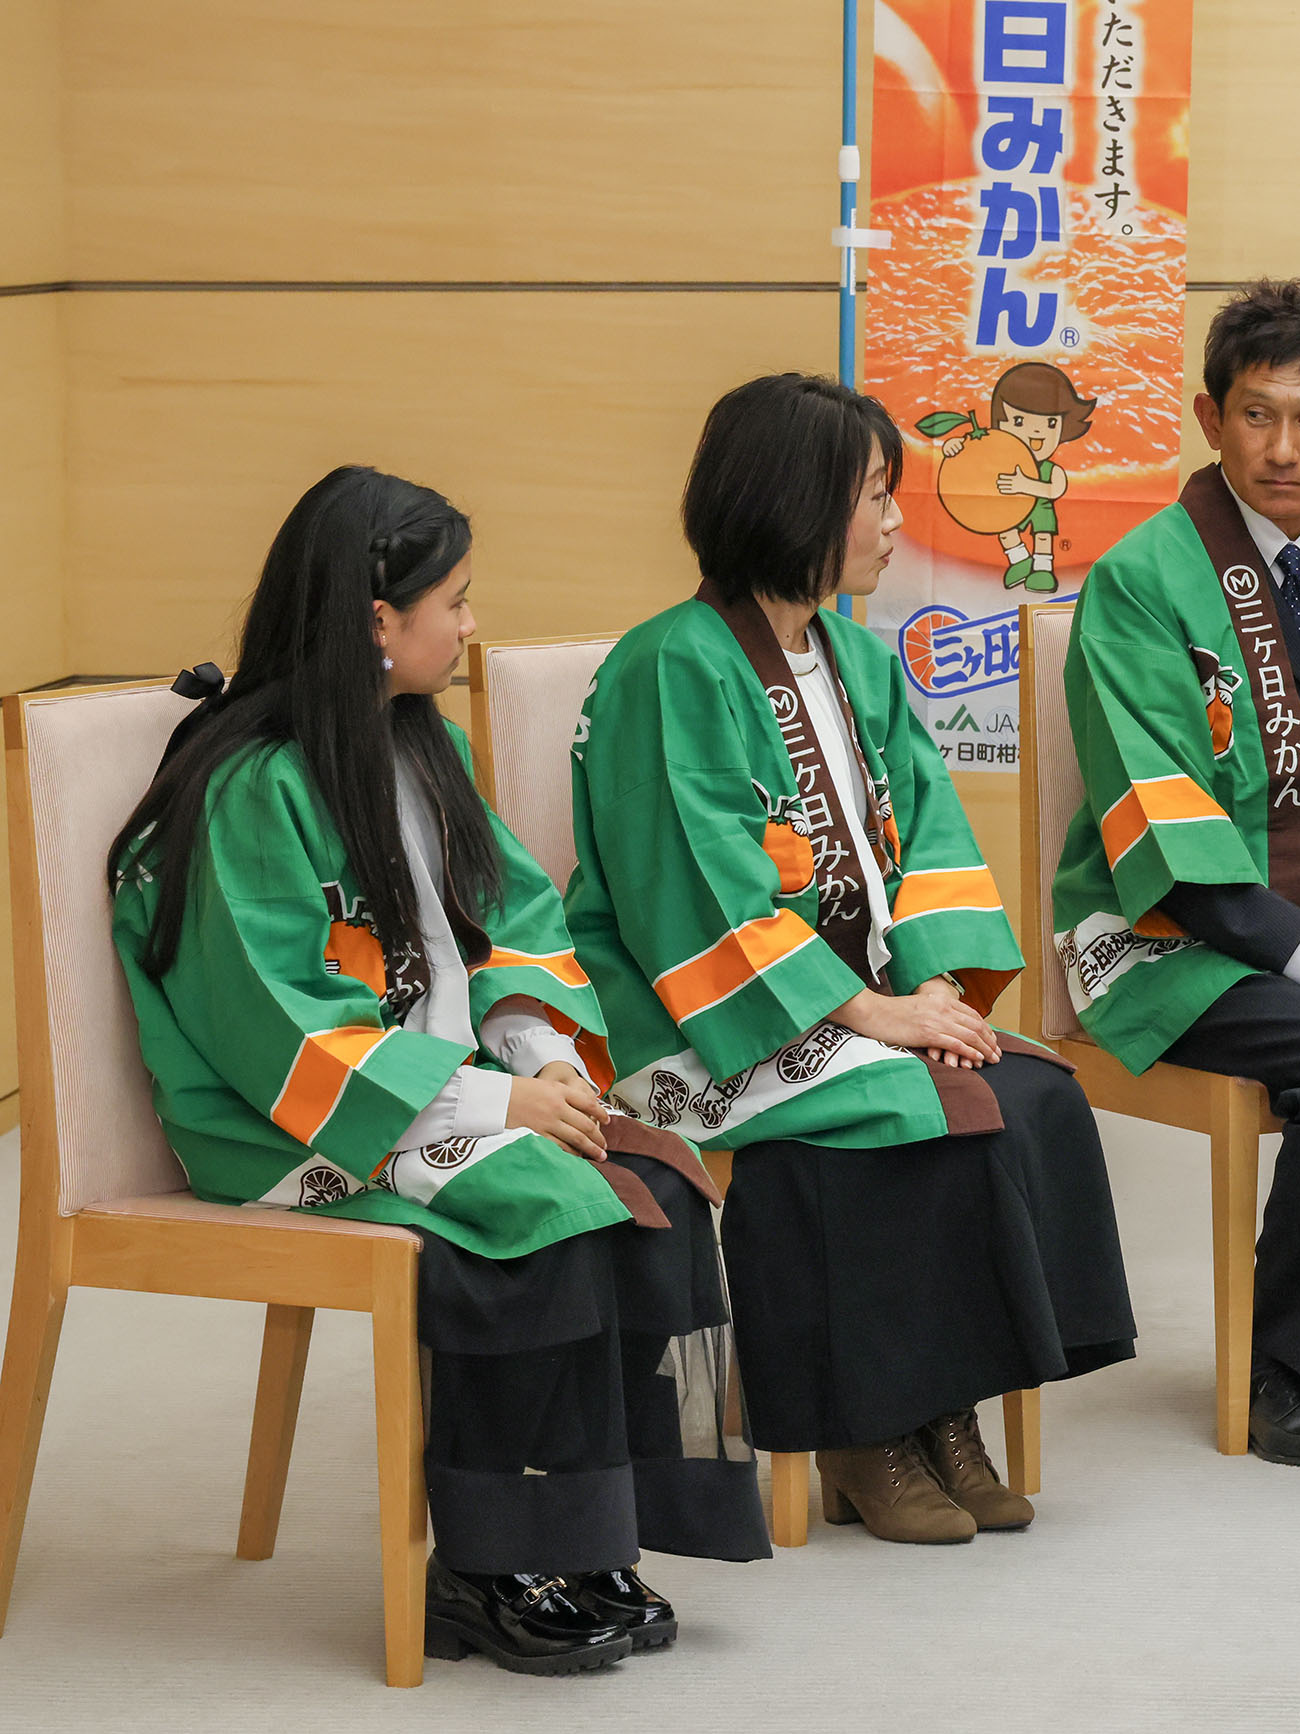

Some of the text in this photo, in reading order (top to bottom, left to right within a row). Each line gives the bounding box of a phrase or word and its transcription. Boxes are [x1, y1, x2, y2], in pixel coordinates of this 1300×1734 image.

[1095, 0, 1133, 236] ただきます。
[986, 713, 1019, 733] JA
[939, 742, 1019, 763] ヶ日町柑
